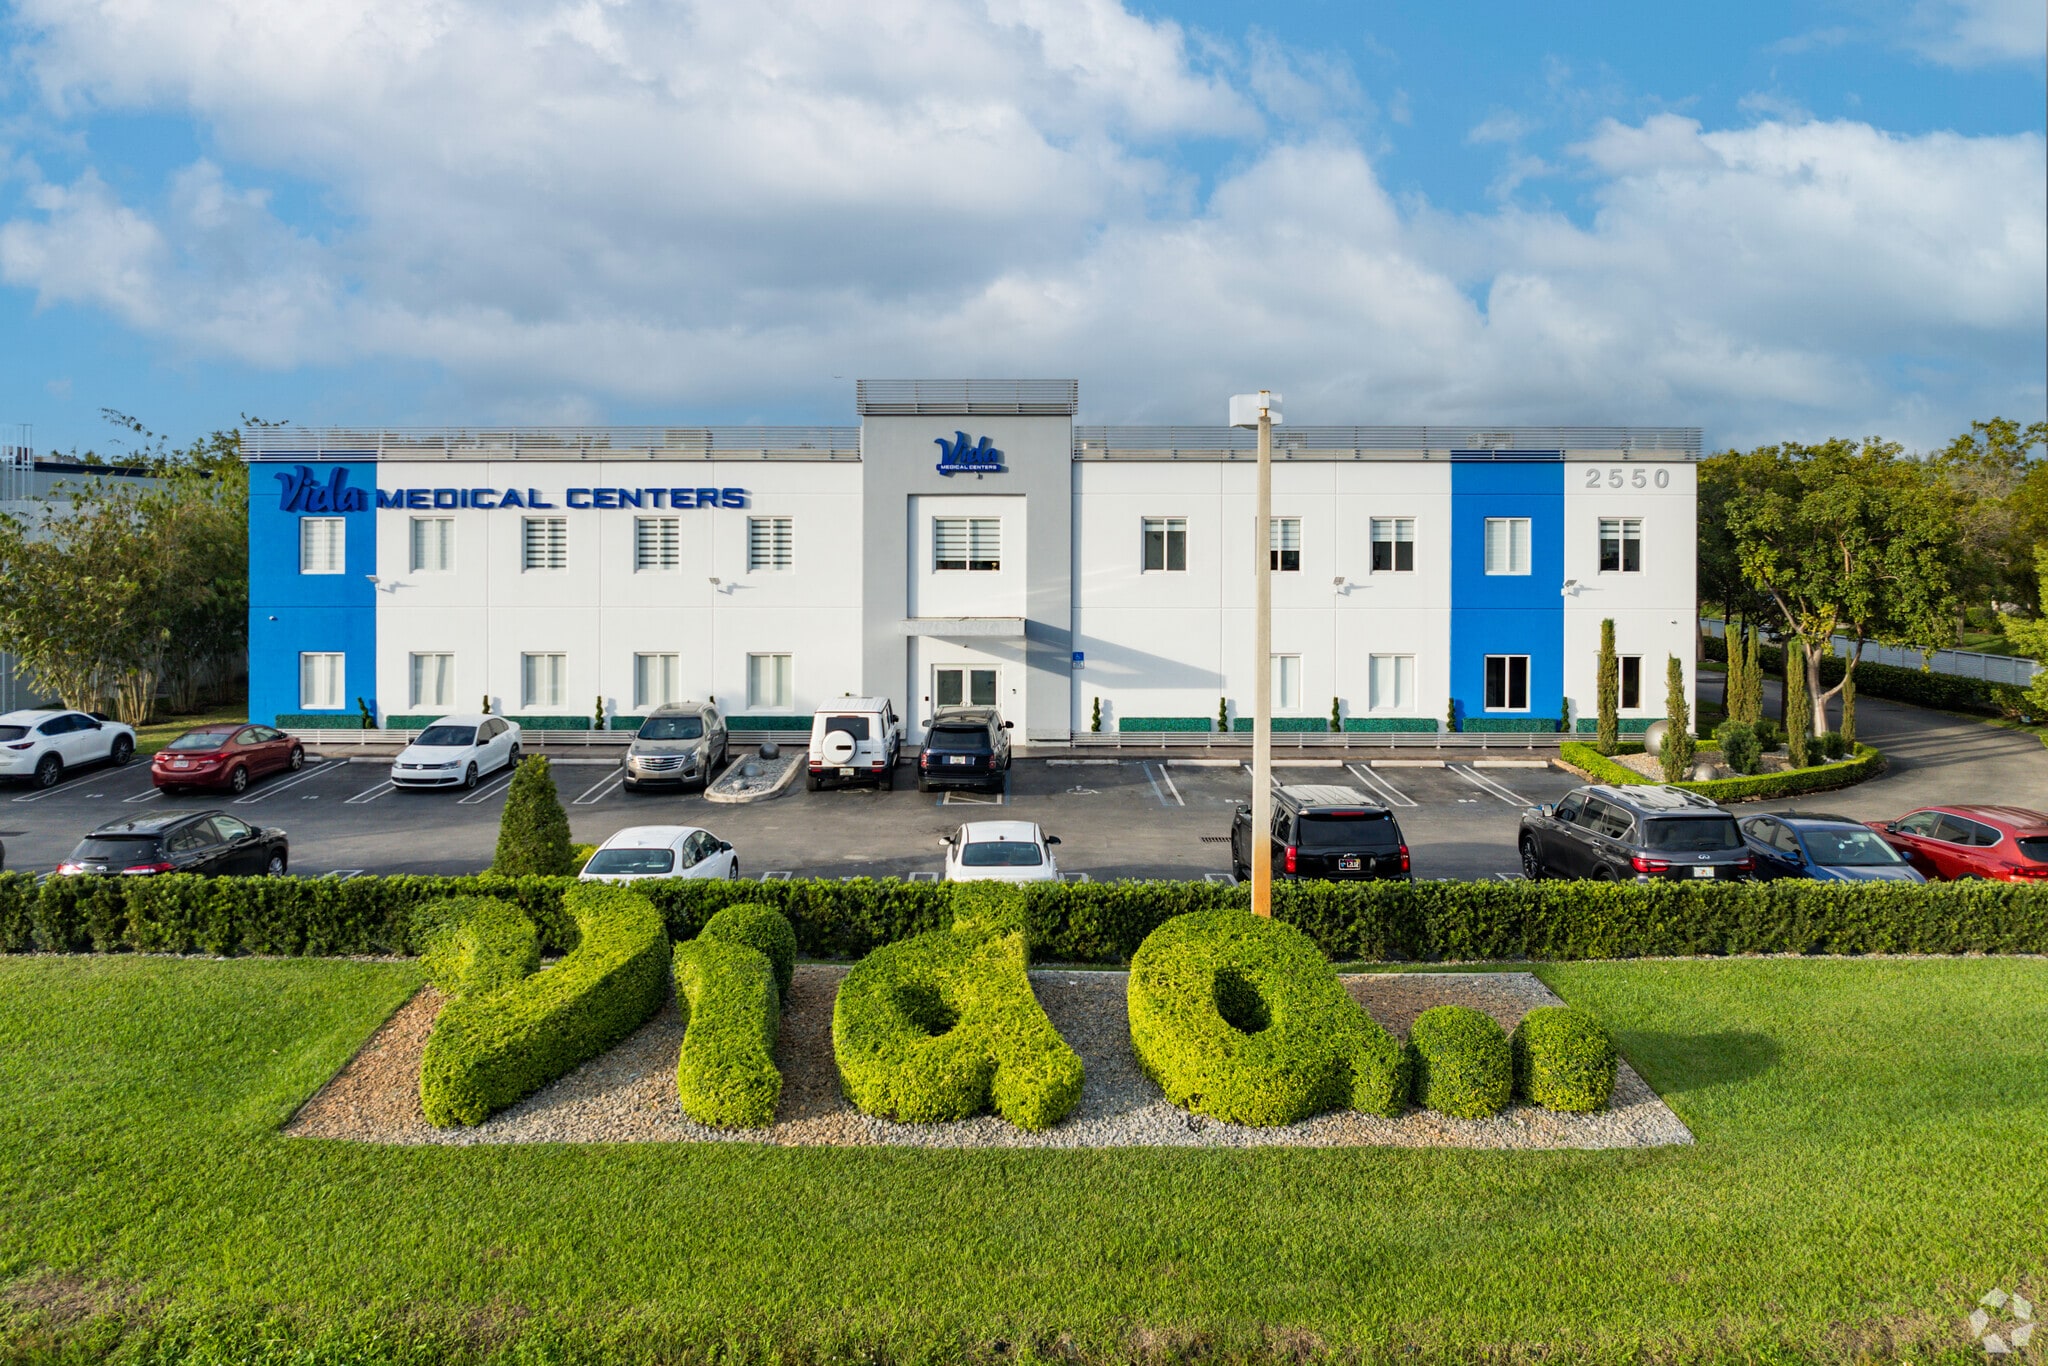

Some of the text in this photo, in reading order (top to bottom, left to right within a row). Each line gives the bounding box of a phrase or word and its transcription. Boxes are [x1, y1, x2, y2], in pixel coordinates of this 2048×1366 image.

[934, 431, 999, 475] Vida
[273, 465, 747, 512] Vida MEDICAL CENTERS
[1585, 468, 1670, 489] 2550
